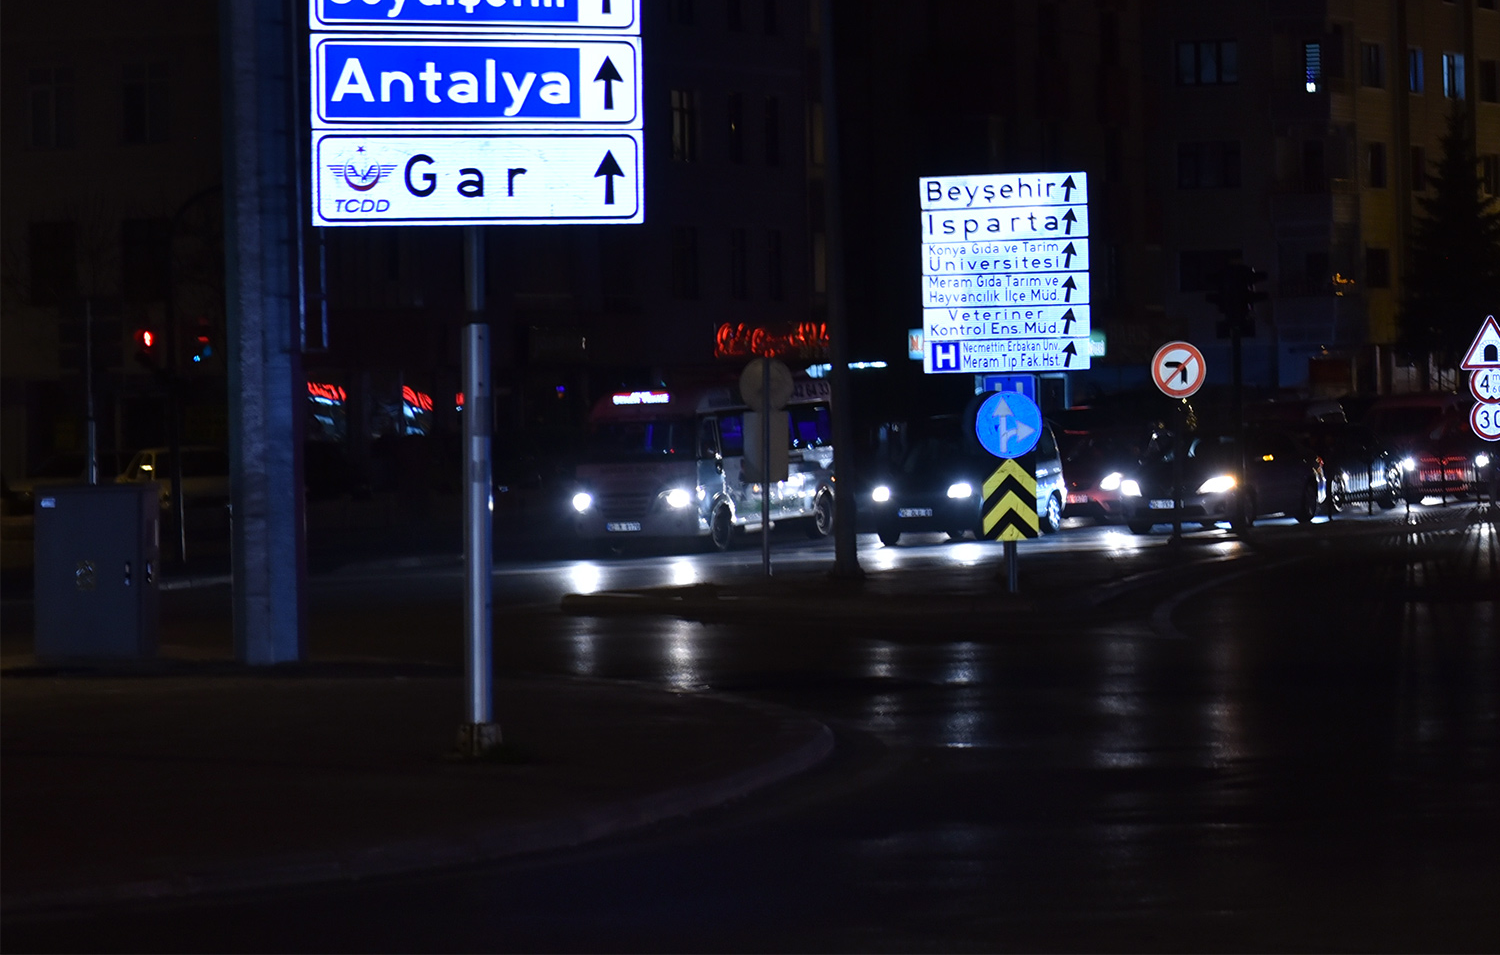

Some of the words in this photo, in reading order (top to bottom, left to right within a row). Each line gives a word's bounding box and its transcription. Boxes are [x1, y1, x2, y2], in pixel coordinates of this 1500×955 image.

[330, 58, 571, 117] Antalya
[404, 154, 528, 197] Gar
[927, 178, 1055, 207] Beyşehir
[335, 200, 390, 213] TCDD
[929, 212, 1058, 240] Isparta
[929, 245, 966, 258] Konya
[930, 256, 1058, 271] Üniversitesi
[930, 276, 972, 288] Meram
[977, 275, 1002, 287] Gıda
[1045, 278, 1058, 286] ve
[930, 290, 1000, 306] Hayvancılık
[1005, 287, 1026, 302] İlçe
[1031, 289, 1060, 301] Müd.
[949, 310, 1043, 321] Veteriner
[931, 323, 986, 336] Kontrol
[991, 323, 1021, 334] Ens.
[1025, 322, 1060, 333] Müd.
[937, 344, 955, 368] H
[963, 342, 1005, 352] Necmettin
[1008, 341, 1041, 352] Erbakan
[963, 355, 999, 368] Meram
[1480, 374, 1490, 393] 4
